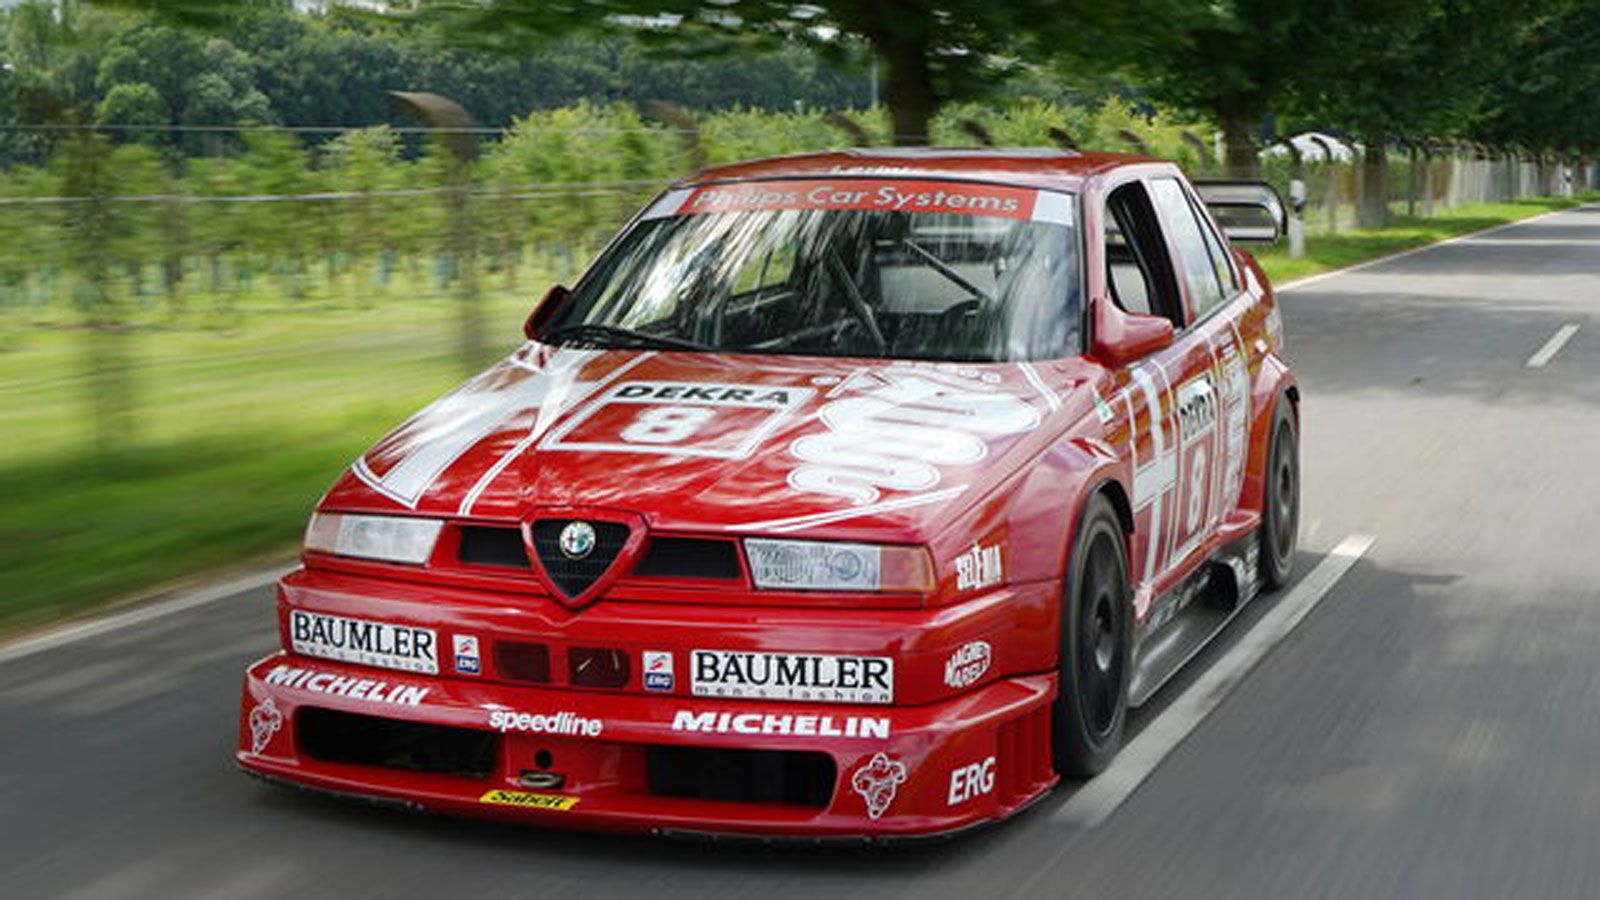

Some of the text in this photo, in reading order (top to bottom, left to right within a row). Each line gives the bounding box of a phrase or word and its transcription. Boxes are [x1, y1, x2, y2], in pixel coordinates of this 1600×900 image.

[807, 186, 869, 205] Car
[873, 186, 1019, 212] Systems
[615, 385, 788, 404] DEKRA
[619, 406, 718, 443] 8
[294, 611, 435, 661] BÄUMLER
[264, 666, 430, 707] MICHELIN
[694, 652, 889, 689] BÄUMLER
[694, 685, 889, 702] men's fashion
[489, 710, 603, 736] speedline
[671, 710, 891, 739] MICHELIN
[947, 756, 996, 805] ERG
